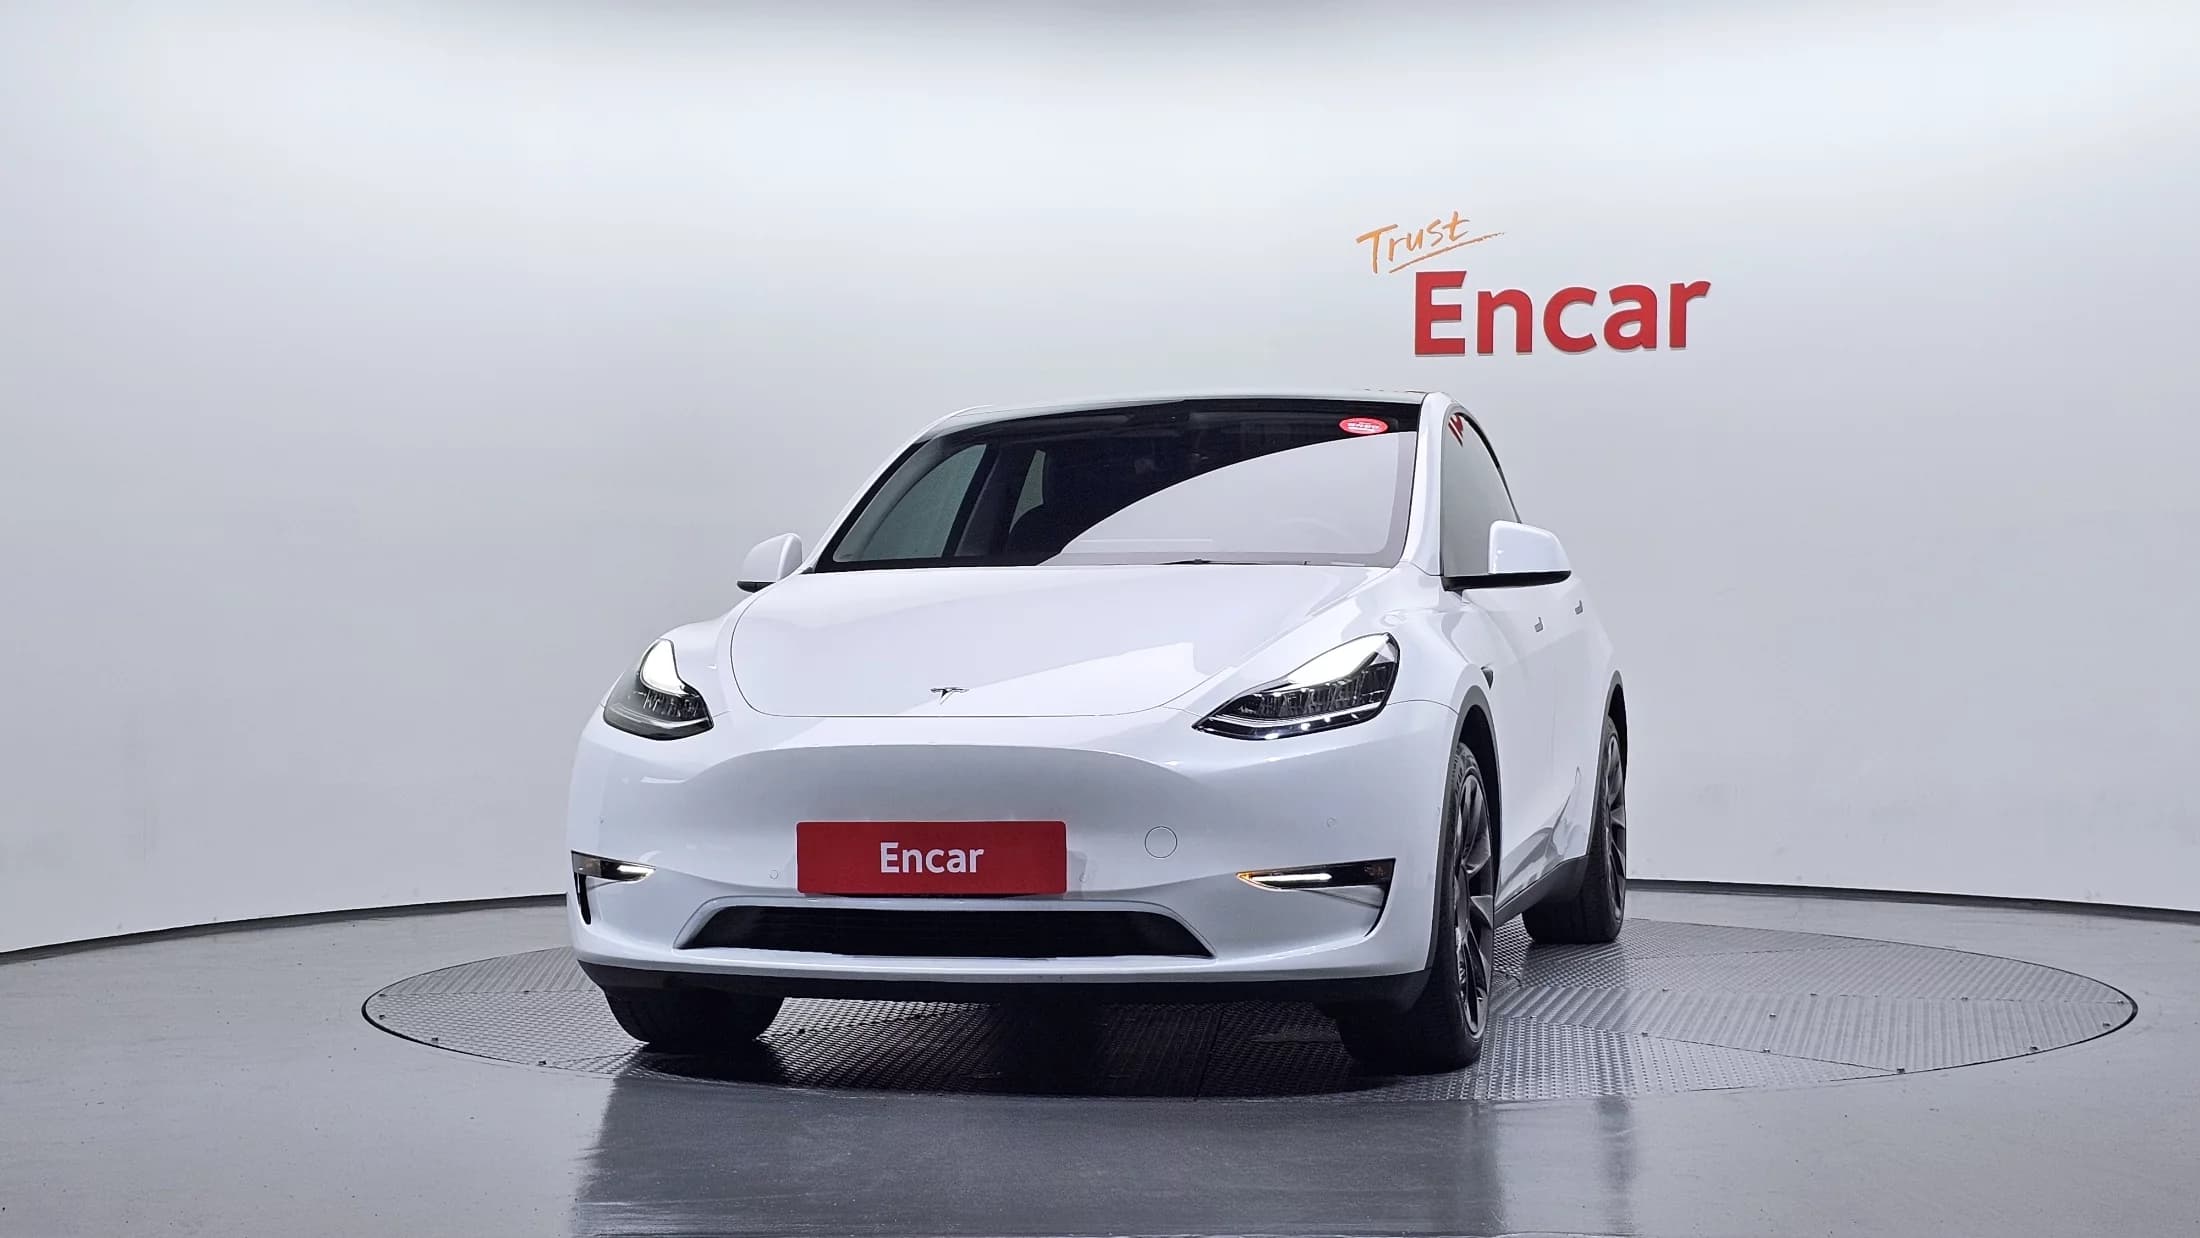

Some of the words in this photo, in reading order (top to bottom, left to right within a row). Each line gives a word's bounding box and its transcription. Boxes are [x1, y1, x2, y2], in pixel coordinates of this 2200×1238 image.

[1356, 210, 1470, 273] Trust
[1414, 270, 1711, 356] Encar
[880, 841, 985, 874] Encar
